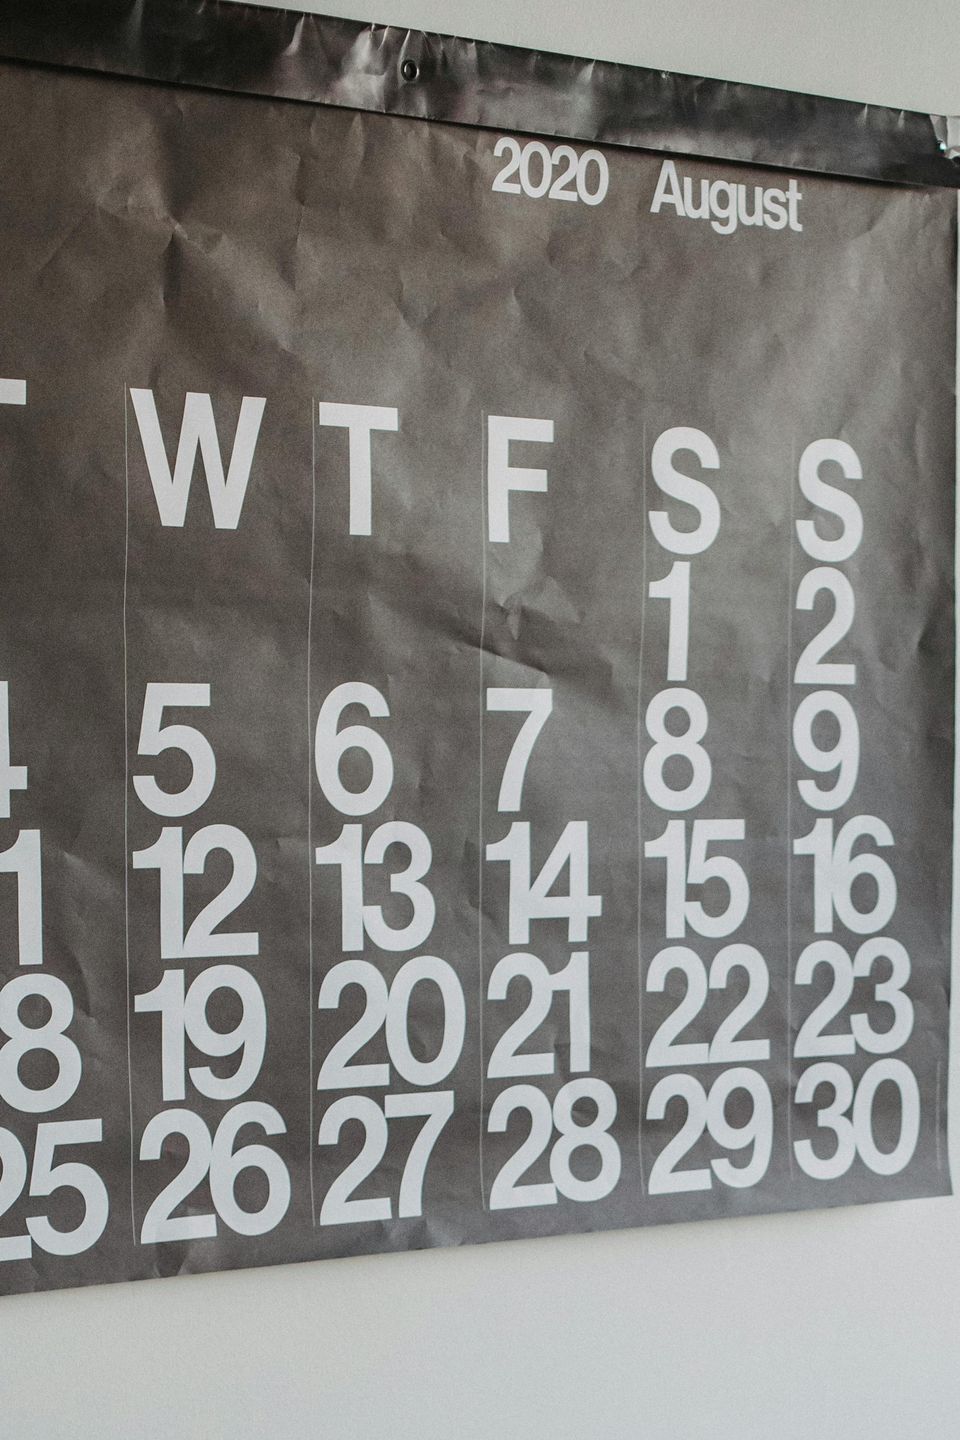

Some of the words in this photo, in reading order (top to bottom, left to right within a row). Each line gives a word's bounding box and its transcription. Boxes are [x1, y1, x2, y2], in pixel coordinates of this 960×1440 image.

[491, 136, 609, 205] 2020
[650, 159, 803, 234] August
[130, 388, 266, 529] W
[319, 402, 398, 536] T
[488, 415, 554, 543] F
[649, 427, 721, 555] S
[795, 439, 864, 562] S
[649, 561, 691, 681] 1
[794, 567, 856, 685] 2
[133, 683, 216, 816] 5
[315, 682, 393, 816] 6
[487, 688, 553, 811] 7
[643, 688, 712, 811] 8
[793, 690, 860, 811] 9
[133, 824, 258, 958] 12
[316, 821, 435, 951] 13
[486, 821, 602, 944] 14
[644, 819, 750, 938] 15
[793, 815, 897, 934] 16
[135, 965, 266, 1101] 19
[317, 956, 465, 1090] 20
[487, 952, 590, 1078] 21
[646, 944, 770, 1067] 22
[794, 937, 914, 1057] 23
[140, 1101, 290, 1244] 26
[319, 1091, 454, 1225] 27
[488, 1078, 621, 1210] 28
[647, 1067, 773, 1195] 29
[793, 1058, 920, 1180] 30
